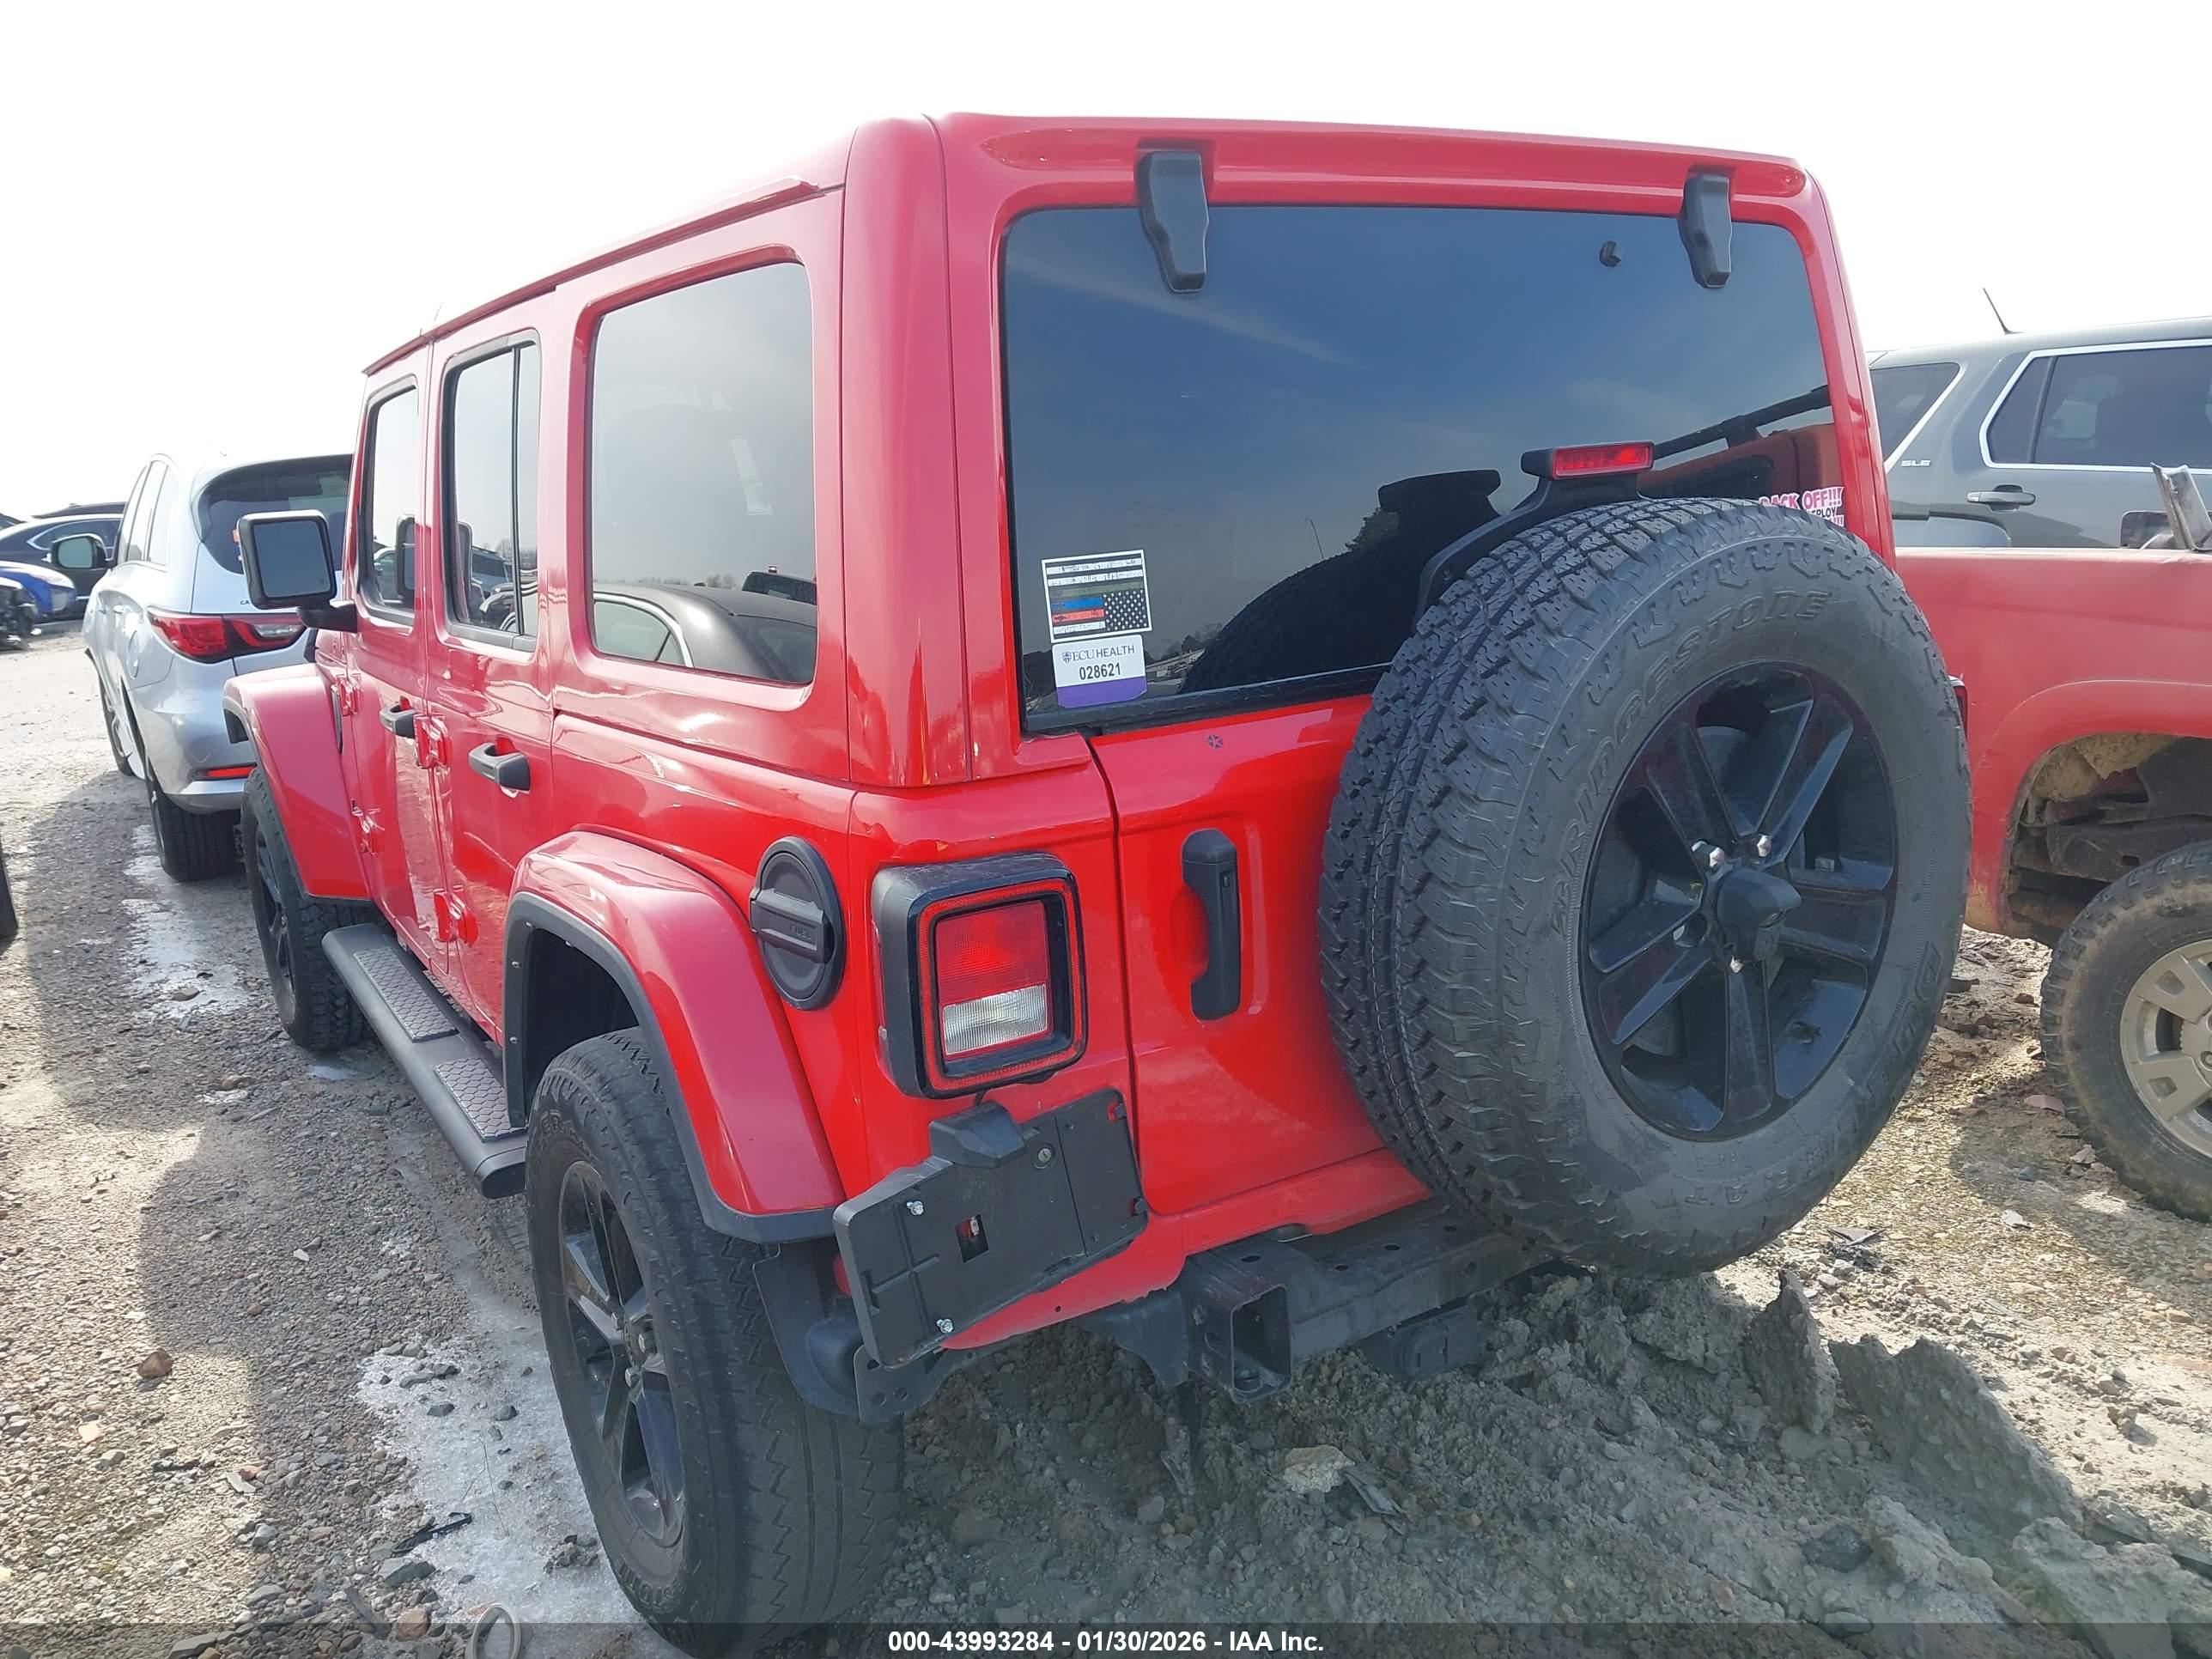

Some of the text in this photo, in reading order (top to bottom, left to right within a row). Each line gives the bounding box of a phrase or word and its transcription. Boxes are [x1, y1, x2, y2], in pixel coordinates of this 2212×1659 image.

[1803, 487, 1843, 510] OFF!!!
[1808, 507, 1836, 519] PLOY
[1073, 645, 1135, 662] ECU HEALTH
[1079, 662, 1121, 681] 028621
[1551, 589, 1831, 936] BRIDGESTONE
